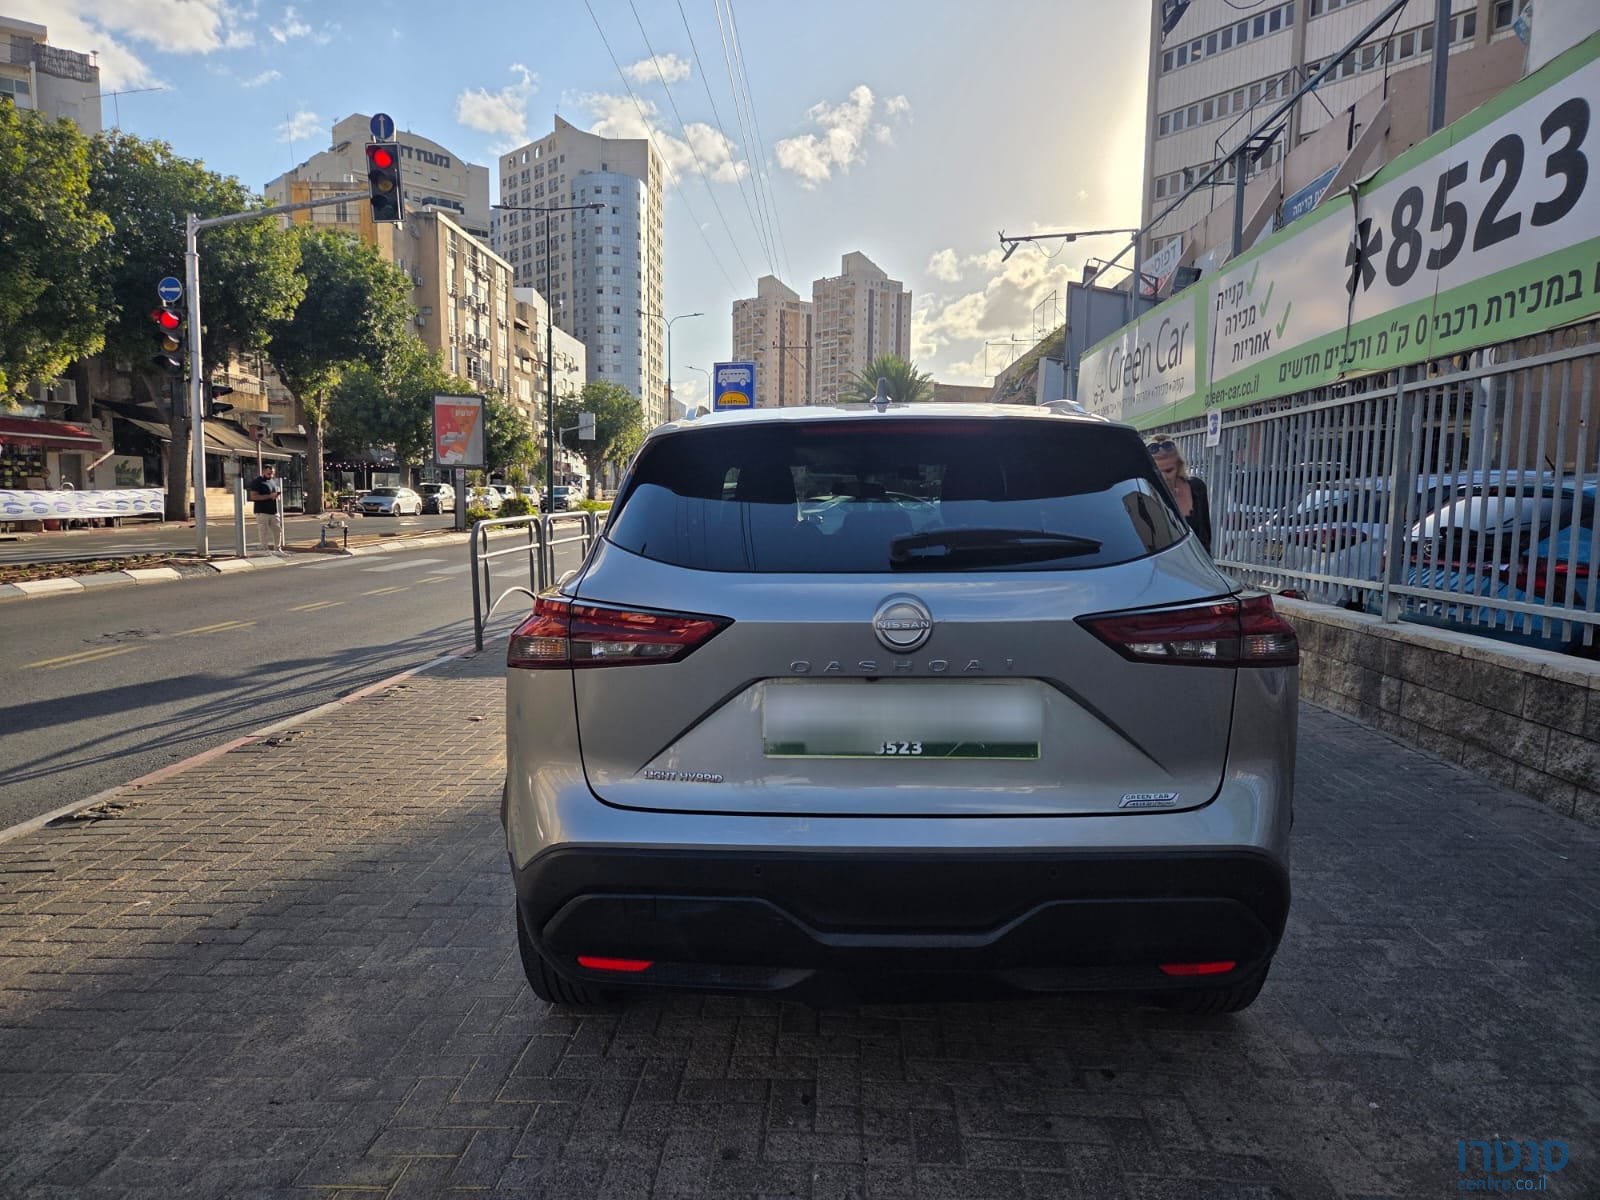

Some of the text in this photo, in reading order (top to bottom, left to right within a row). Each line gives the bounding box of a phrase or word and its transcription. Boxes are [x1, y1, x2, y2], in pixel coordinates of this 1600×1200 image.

[1216, 280, 1244, 311] קנייה
[1484, 269, 1583, 326] במכירת
[1224, 305, 1256, 336] מכירה
[1415, 314, 1428, 345] 0
[1433, 303, 1478, 340] רכבי
[1109, 318, 1189, 394] Green Car
[1231, 329, 1271, 363] אחריות
[1324, 336, 1372, 370] ורכבים
[1278, 353, 1320, 383] חדשים
[877, 620, 930, 630] NISSAN
[644, 770, 723, 783] LIGHT HYBRID
